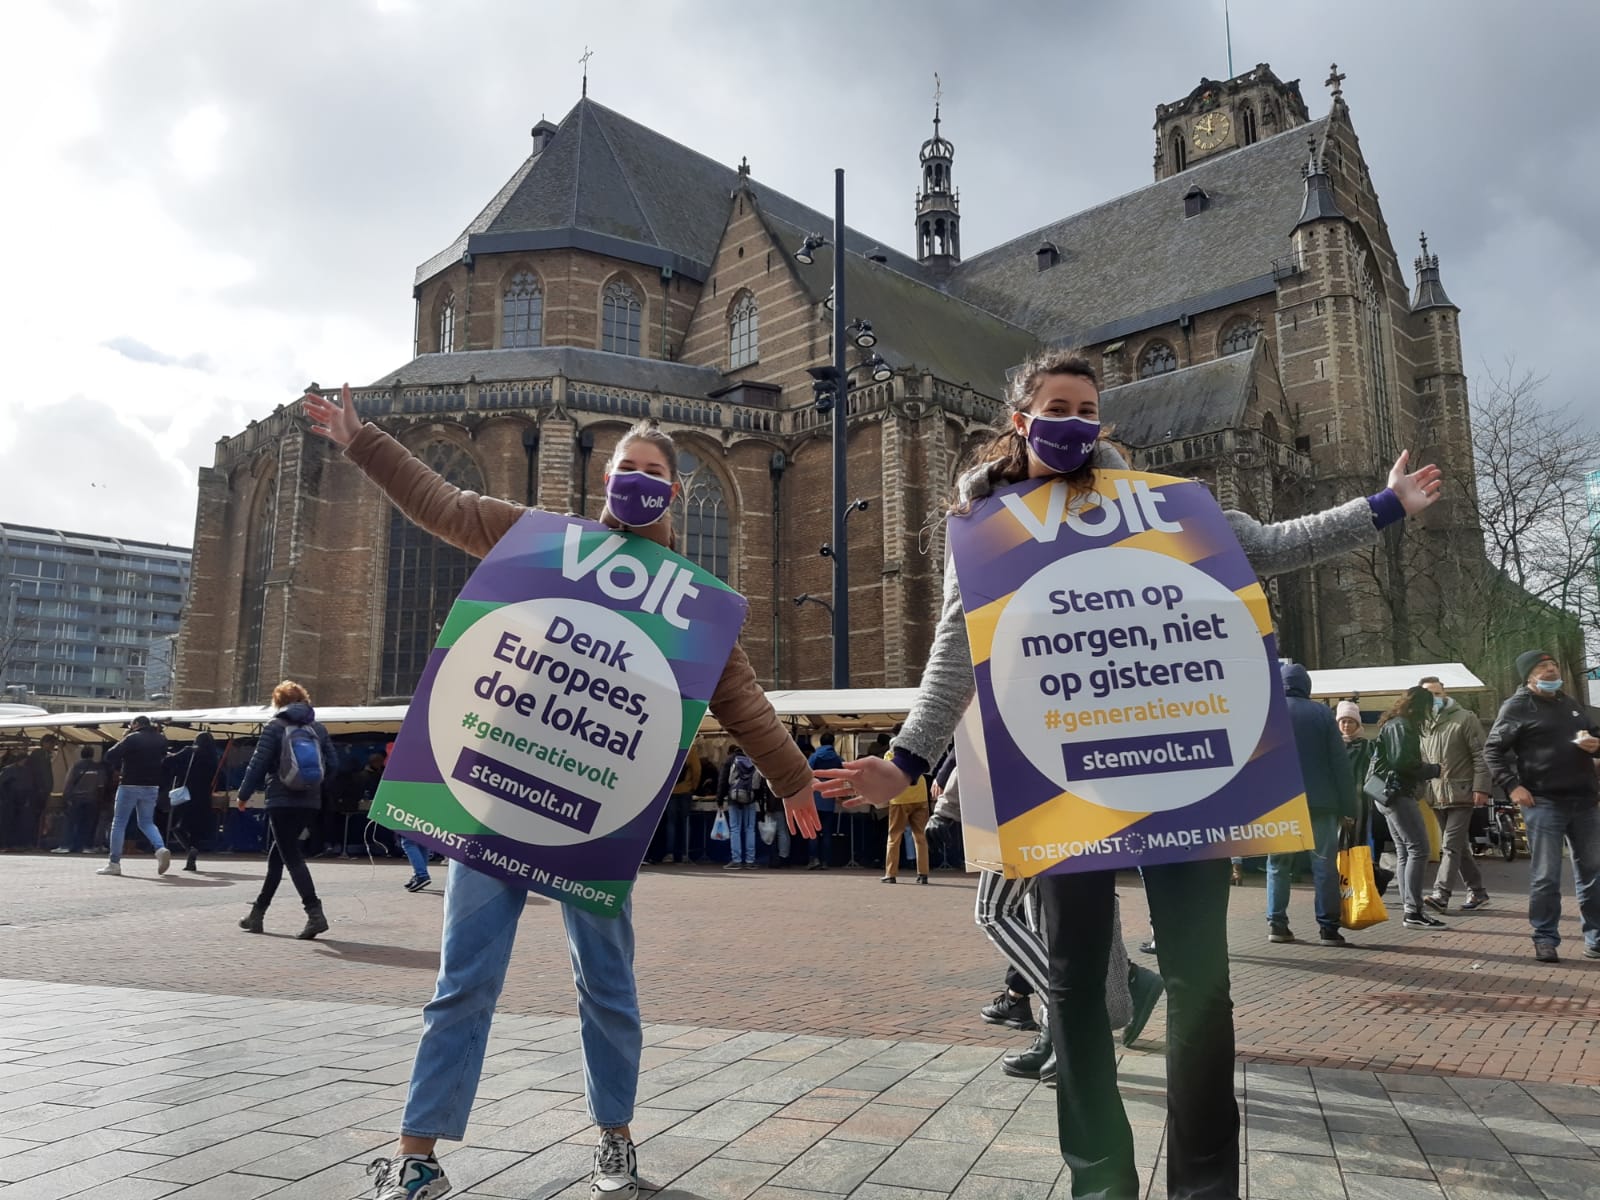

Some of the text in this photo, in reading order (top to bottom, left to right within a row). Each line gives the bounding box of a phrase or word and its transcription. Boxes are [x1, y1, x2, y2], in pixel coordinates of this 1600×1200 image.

[641, 495, 664, 508] Volt
[1000, 479, 1184, 543] Volt
[562, 523, 700, 630] Volt
[1049, 585, 1183, 615] Stem op
[544, 615, 634, 673] Denk
[1021, 613, 1228, 657] morgen, niet
[493, 631, 650, 725] Europees,
[1040, 659, 1225, 701] op gisteren
[474, 671, 643, 761] doe lokaal
[1044, 693, 1230, 733] #generatievolt
[461, 711, 619, 790] #generatievolt
[1082, 737, 1215, 771] stemvolt.nl
[469, 763, 583, 821] stemvolt.nl
[386, 803, 616, 907] TOEKOMST MADE IN EUROPE
[1018, 820, 1301, 862] TOEKOMST MADE IN EUROPE
